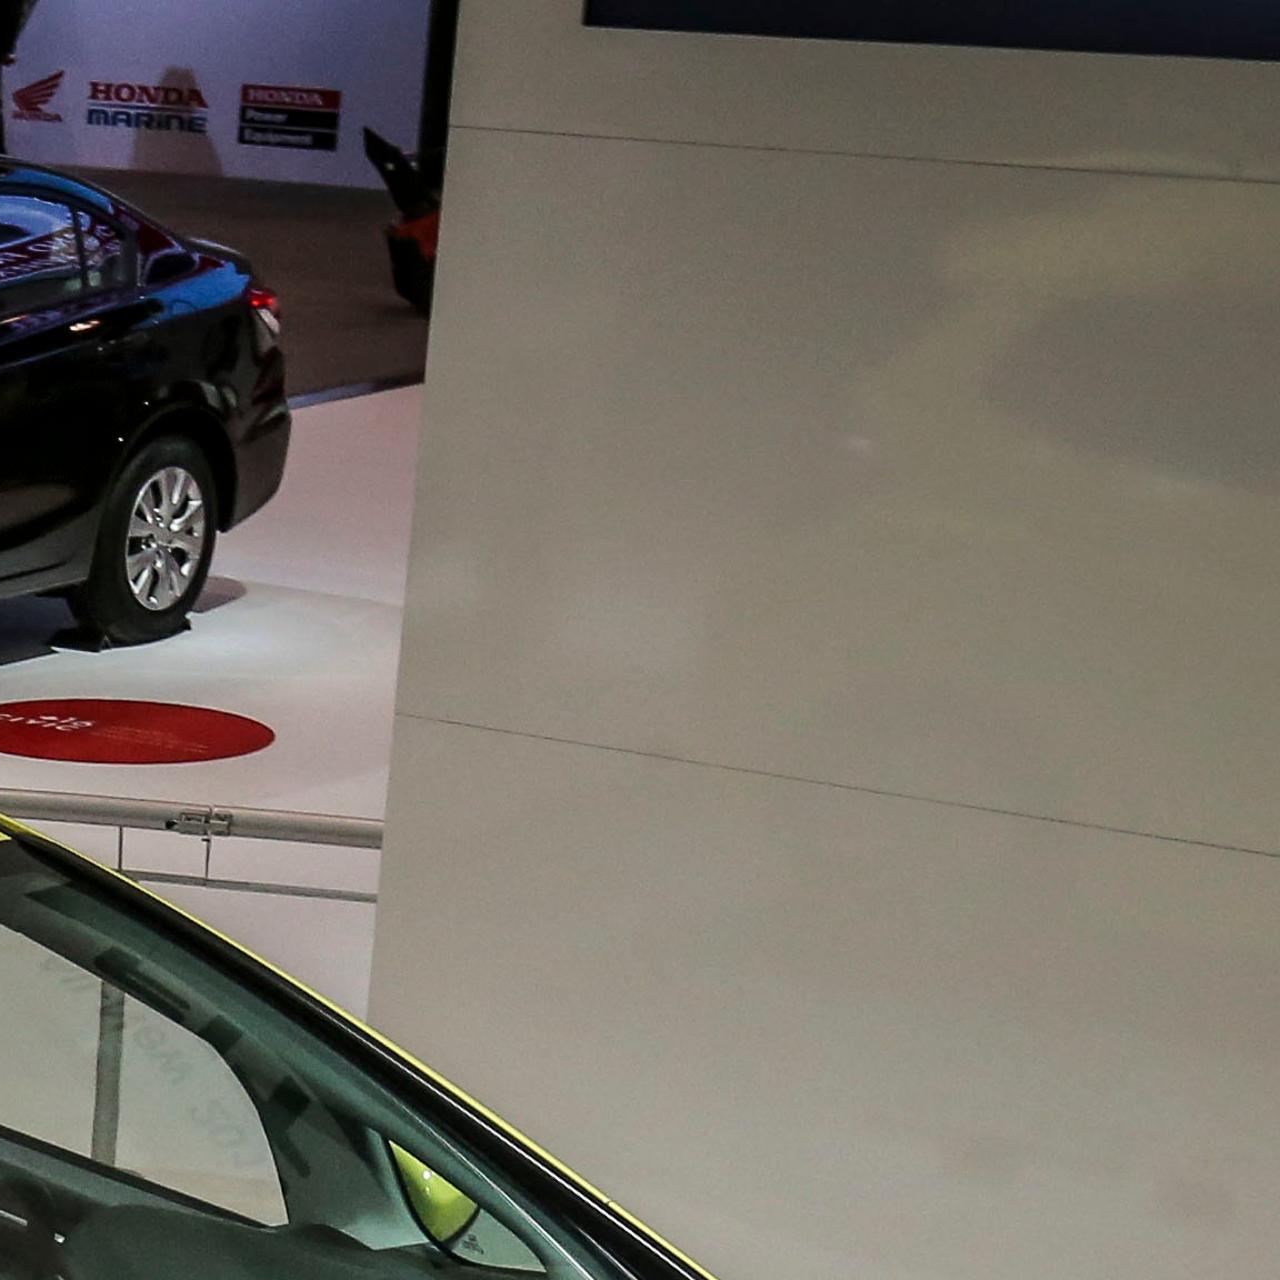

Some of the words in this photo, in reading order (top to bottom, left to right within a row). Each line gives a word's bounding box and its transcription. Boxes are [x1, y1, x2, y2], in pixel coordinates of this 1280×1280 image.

[88, 81, 209, 108] HONDA
[248, 88, 324, 106] HONDA
[87, 107, 208, 133] MARINE
